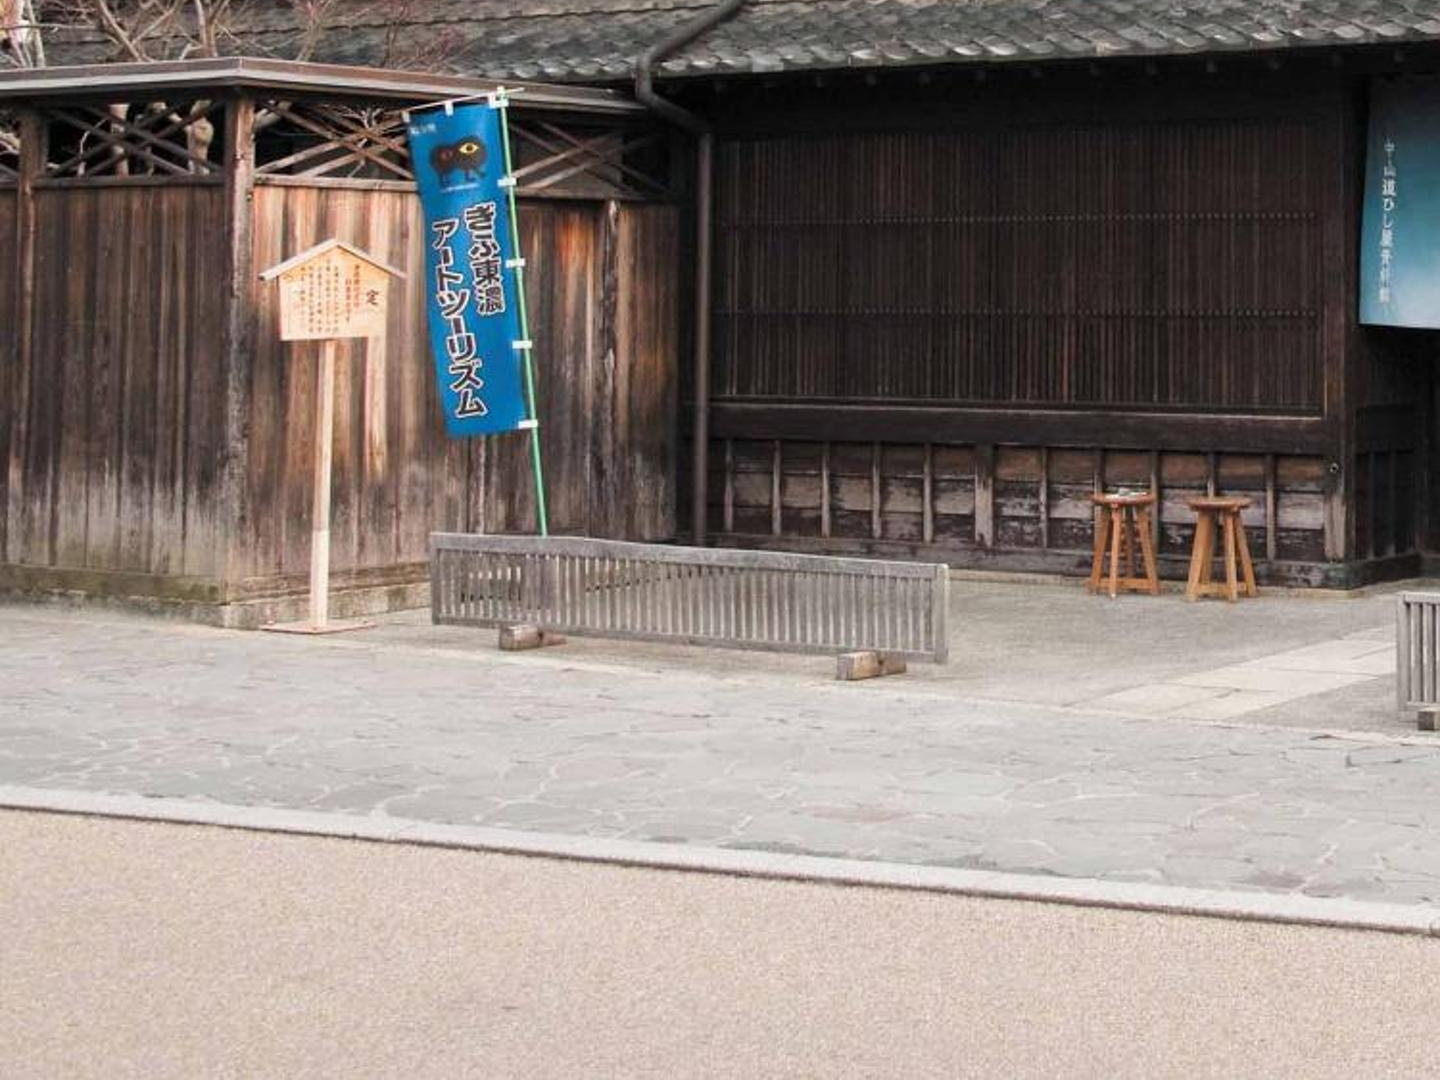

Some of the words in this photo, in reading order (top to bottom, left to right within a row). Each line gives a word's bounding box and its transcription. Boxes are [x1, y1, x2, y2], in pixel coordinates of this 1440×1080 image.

[433, 219, 486, 417] アートツーリズム
[464, 202, 505, 316] ぎふ東濃
